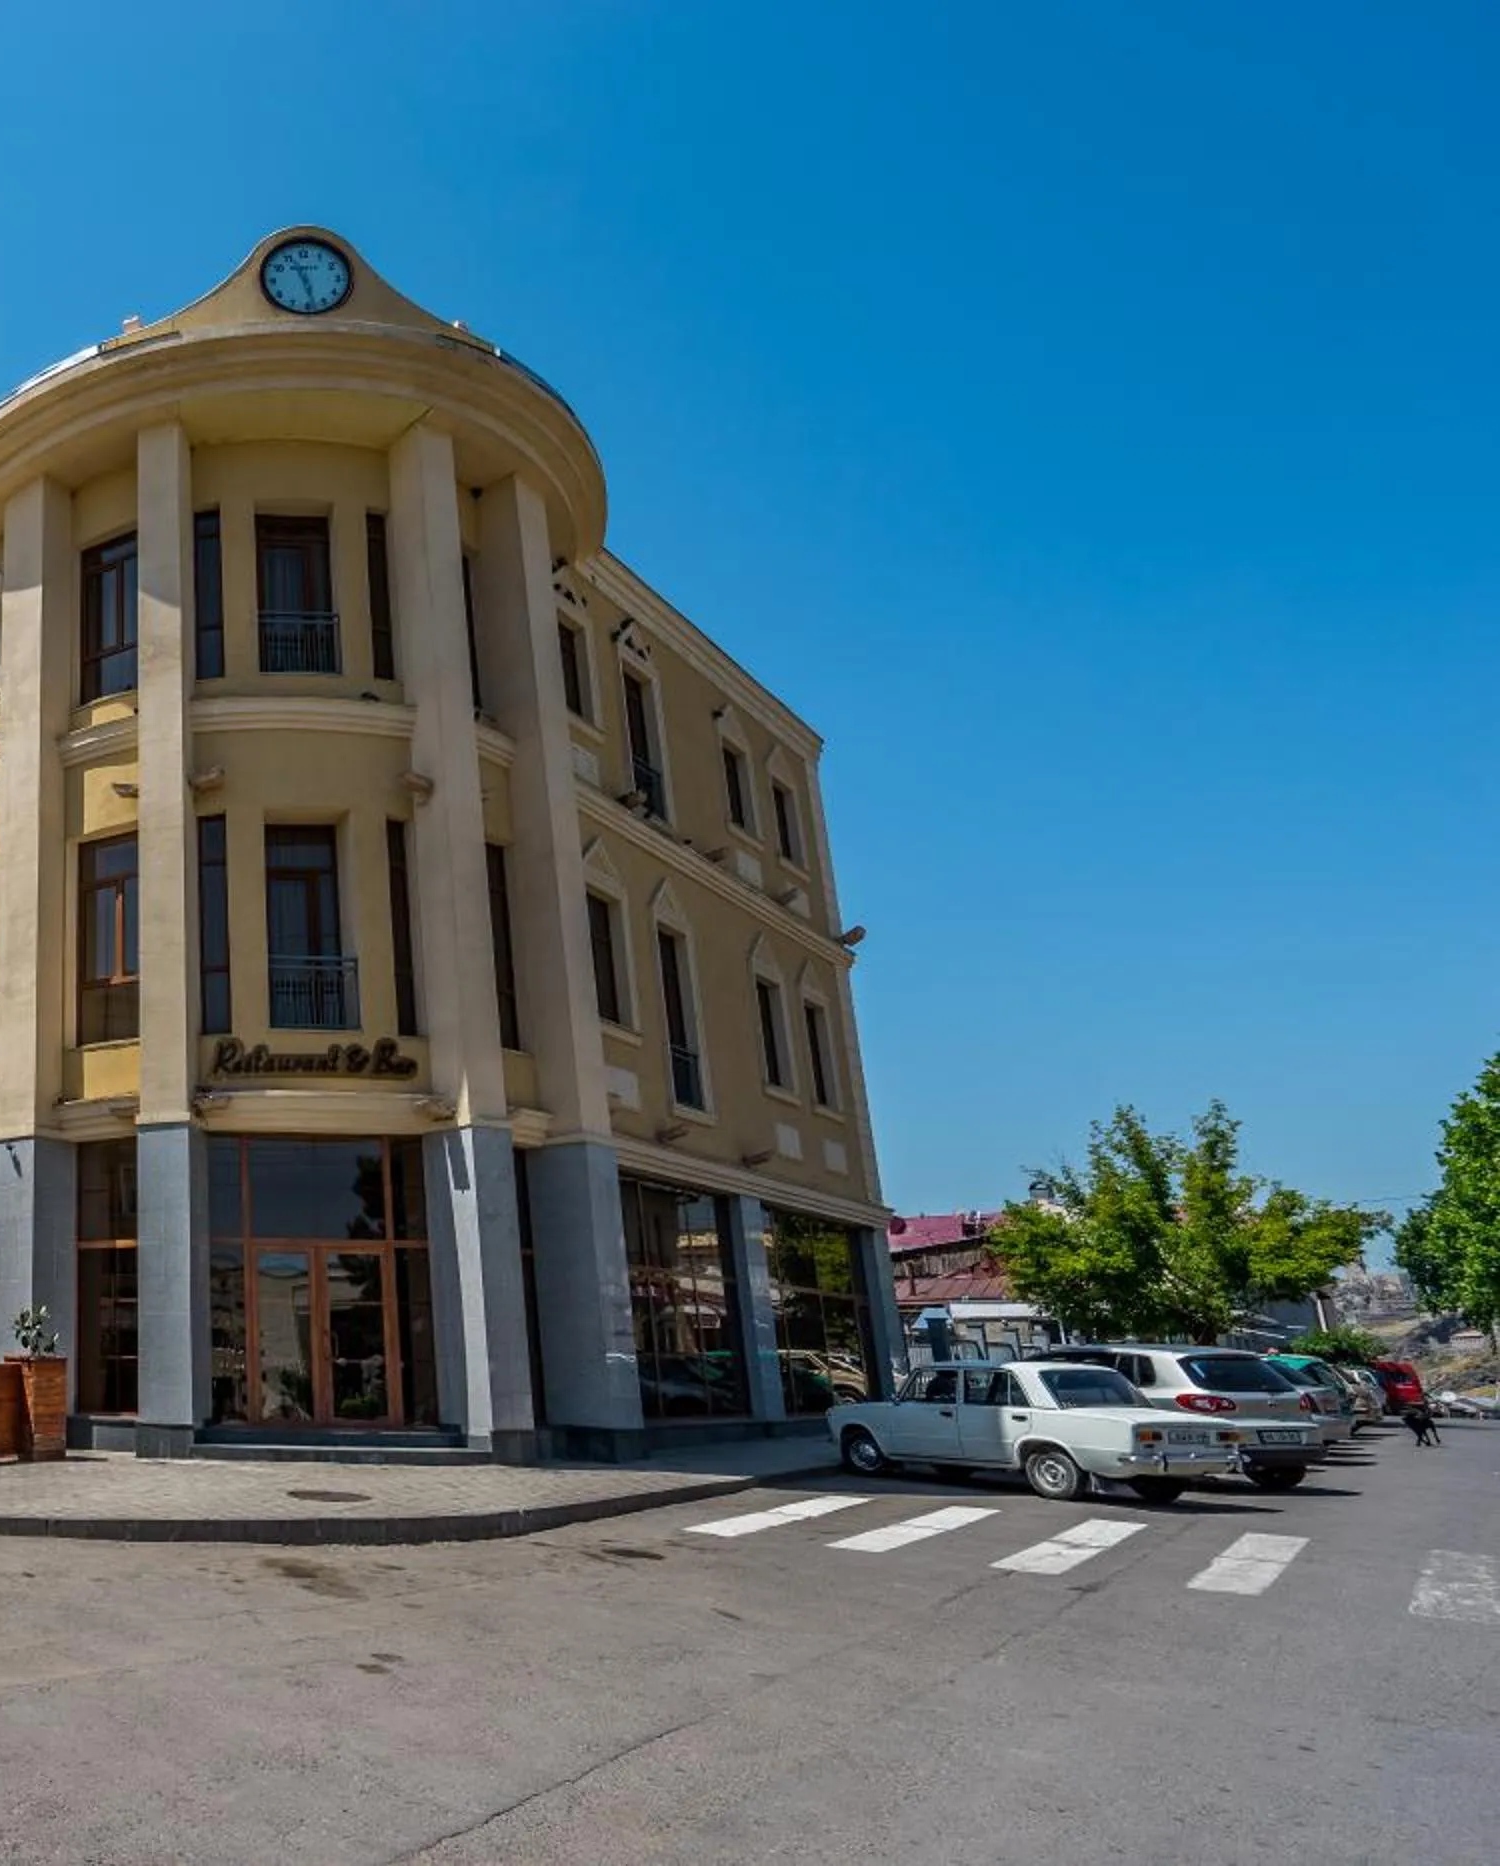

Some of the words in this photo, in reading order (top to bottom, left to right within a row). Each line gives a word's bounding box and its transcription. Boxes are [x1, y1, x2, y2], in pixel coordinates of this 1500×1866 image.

[208, 1037, 343, 1077] Restaurant
[345, 1043, 370, 1073] &
[372, 1037, 418, 1078] Bar
